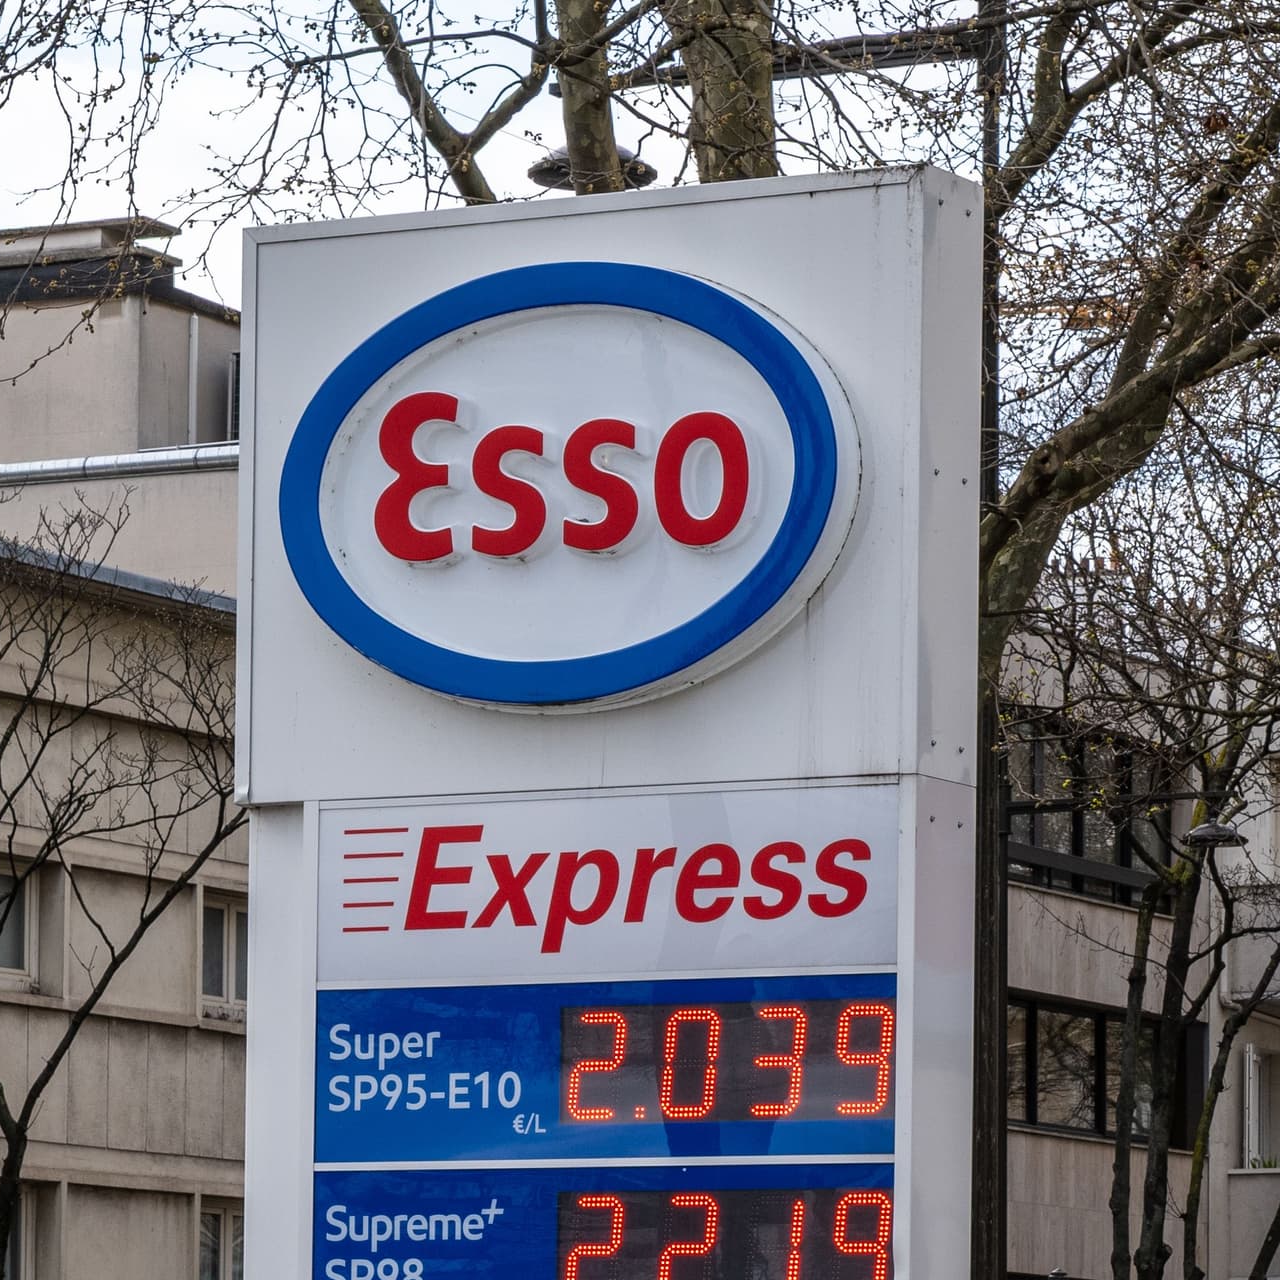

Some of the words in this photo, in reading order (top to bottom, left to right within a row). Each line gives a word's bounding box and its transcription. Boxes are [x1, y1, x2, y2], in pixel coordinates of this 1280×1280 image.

[404, 824, 871, 953] Express
[328, 1023, 440, 1070] Super
[568, 1004, 894, 1121] 2.039
[328, 1070, 521, 1112] SP95-E10
[512, 1113, 546, 1135] €/L
[325, 1199, 504, 1252] Supreme+
